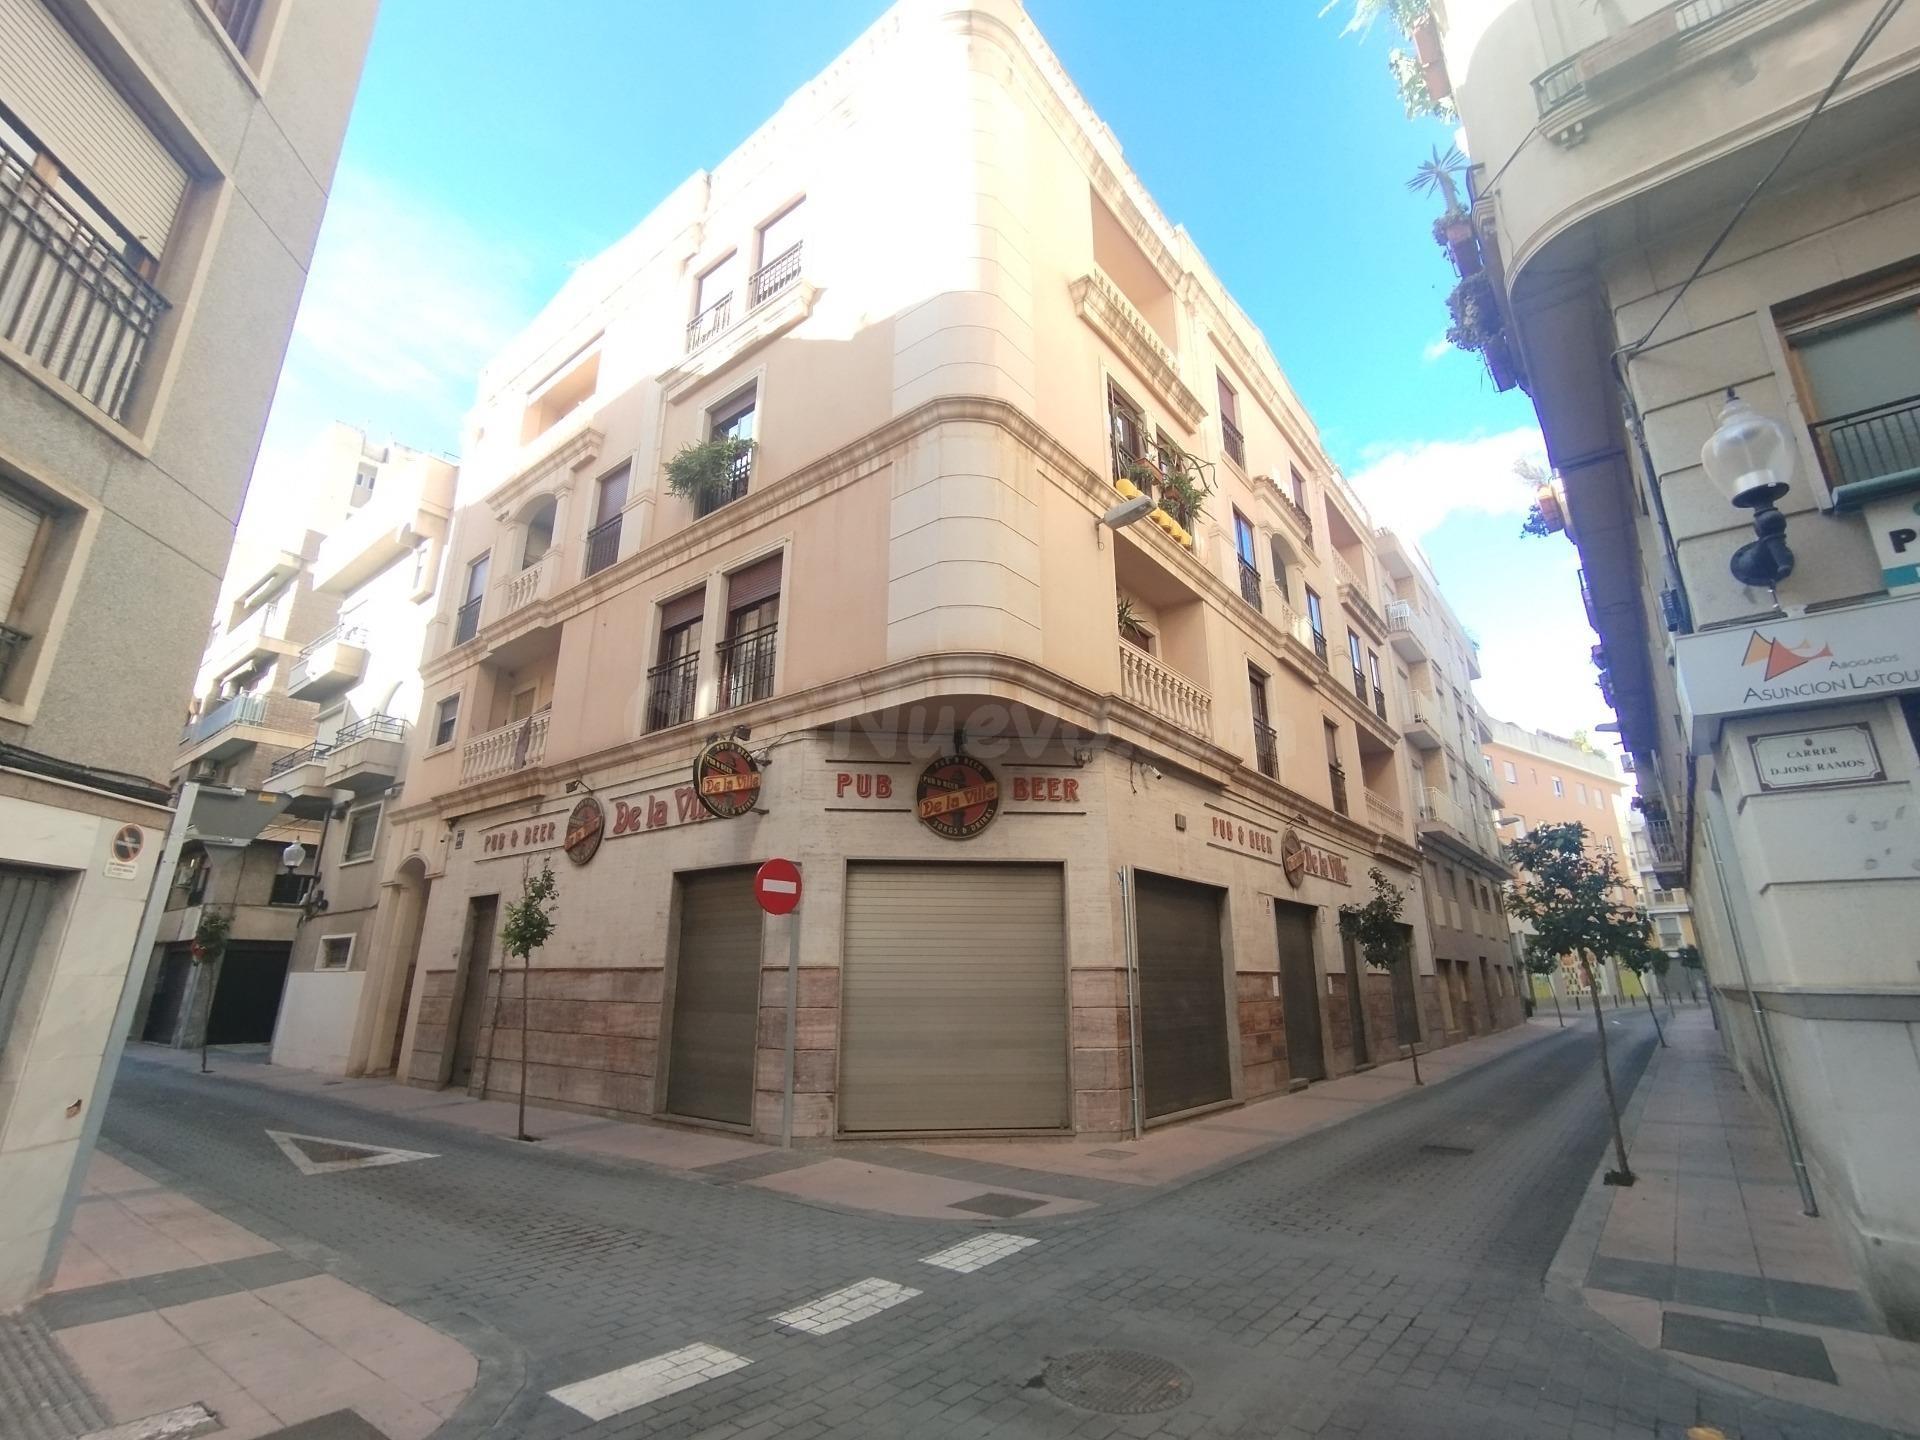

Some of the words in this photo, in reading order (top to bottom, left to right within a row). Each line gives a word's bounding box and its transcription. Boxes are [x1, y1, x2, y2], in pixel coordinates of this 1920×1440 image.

[1744, 679, 1847, 703] ASUNCION
[1848, 669, 1920, 689] LATOU
[1786, 746, 1838, 759] CARRER
[1817, 759, 1866, 771] RAMOS
[836, 772, 893, 798] PUB
[1013, 777, 1080, 802] BEER
[922, 801, 942, 816] De
[946, 796, 960, 809] la
[963, 785, 995, 803] Ville
[613, 801, 642, 834] De
[646, 794, 668, 827] la
[484, 832, 505, 852] PUB
[524, 821, 556, 846] BEER
[1212, 816, 1233, 841] PUB
[1249, 830, 1273, 855] BEER
[1305, 845, 1318, 873] De
[1318, 850, 1328, 877] la
[1328, 854, 1348, 883] Ville
